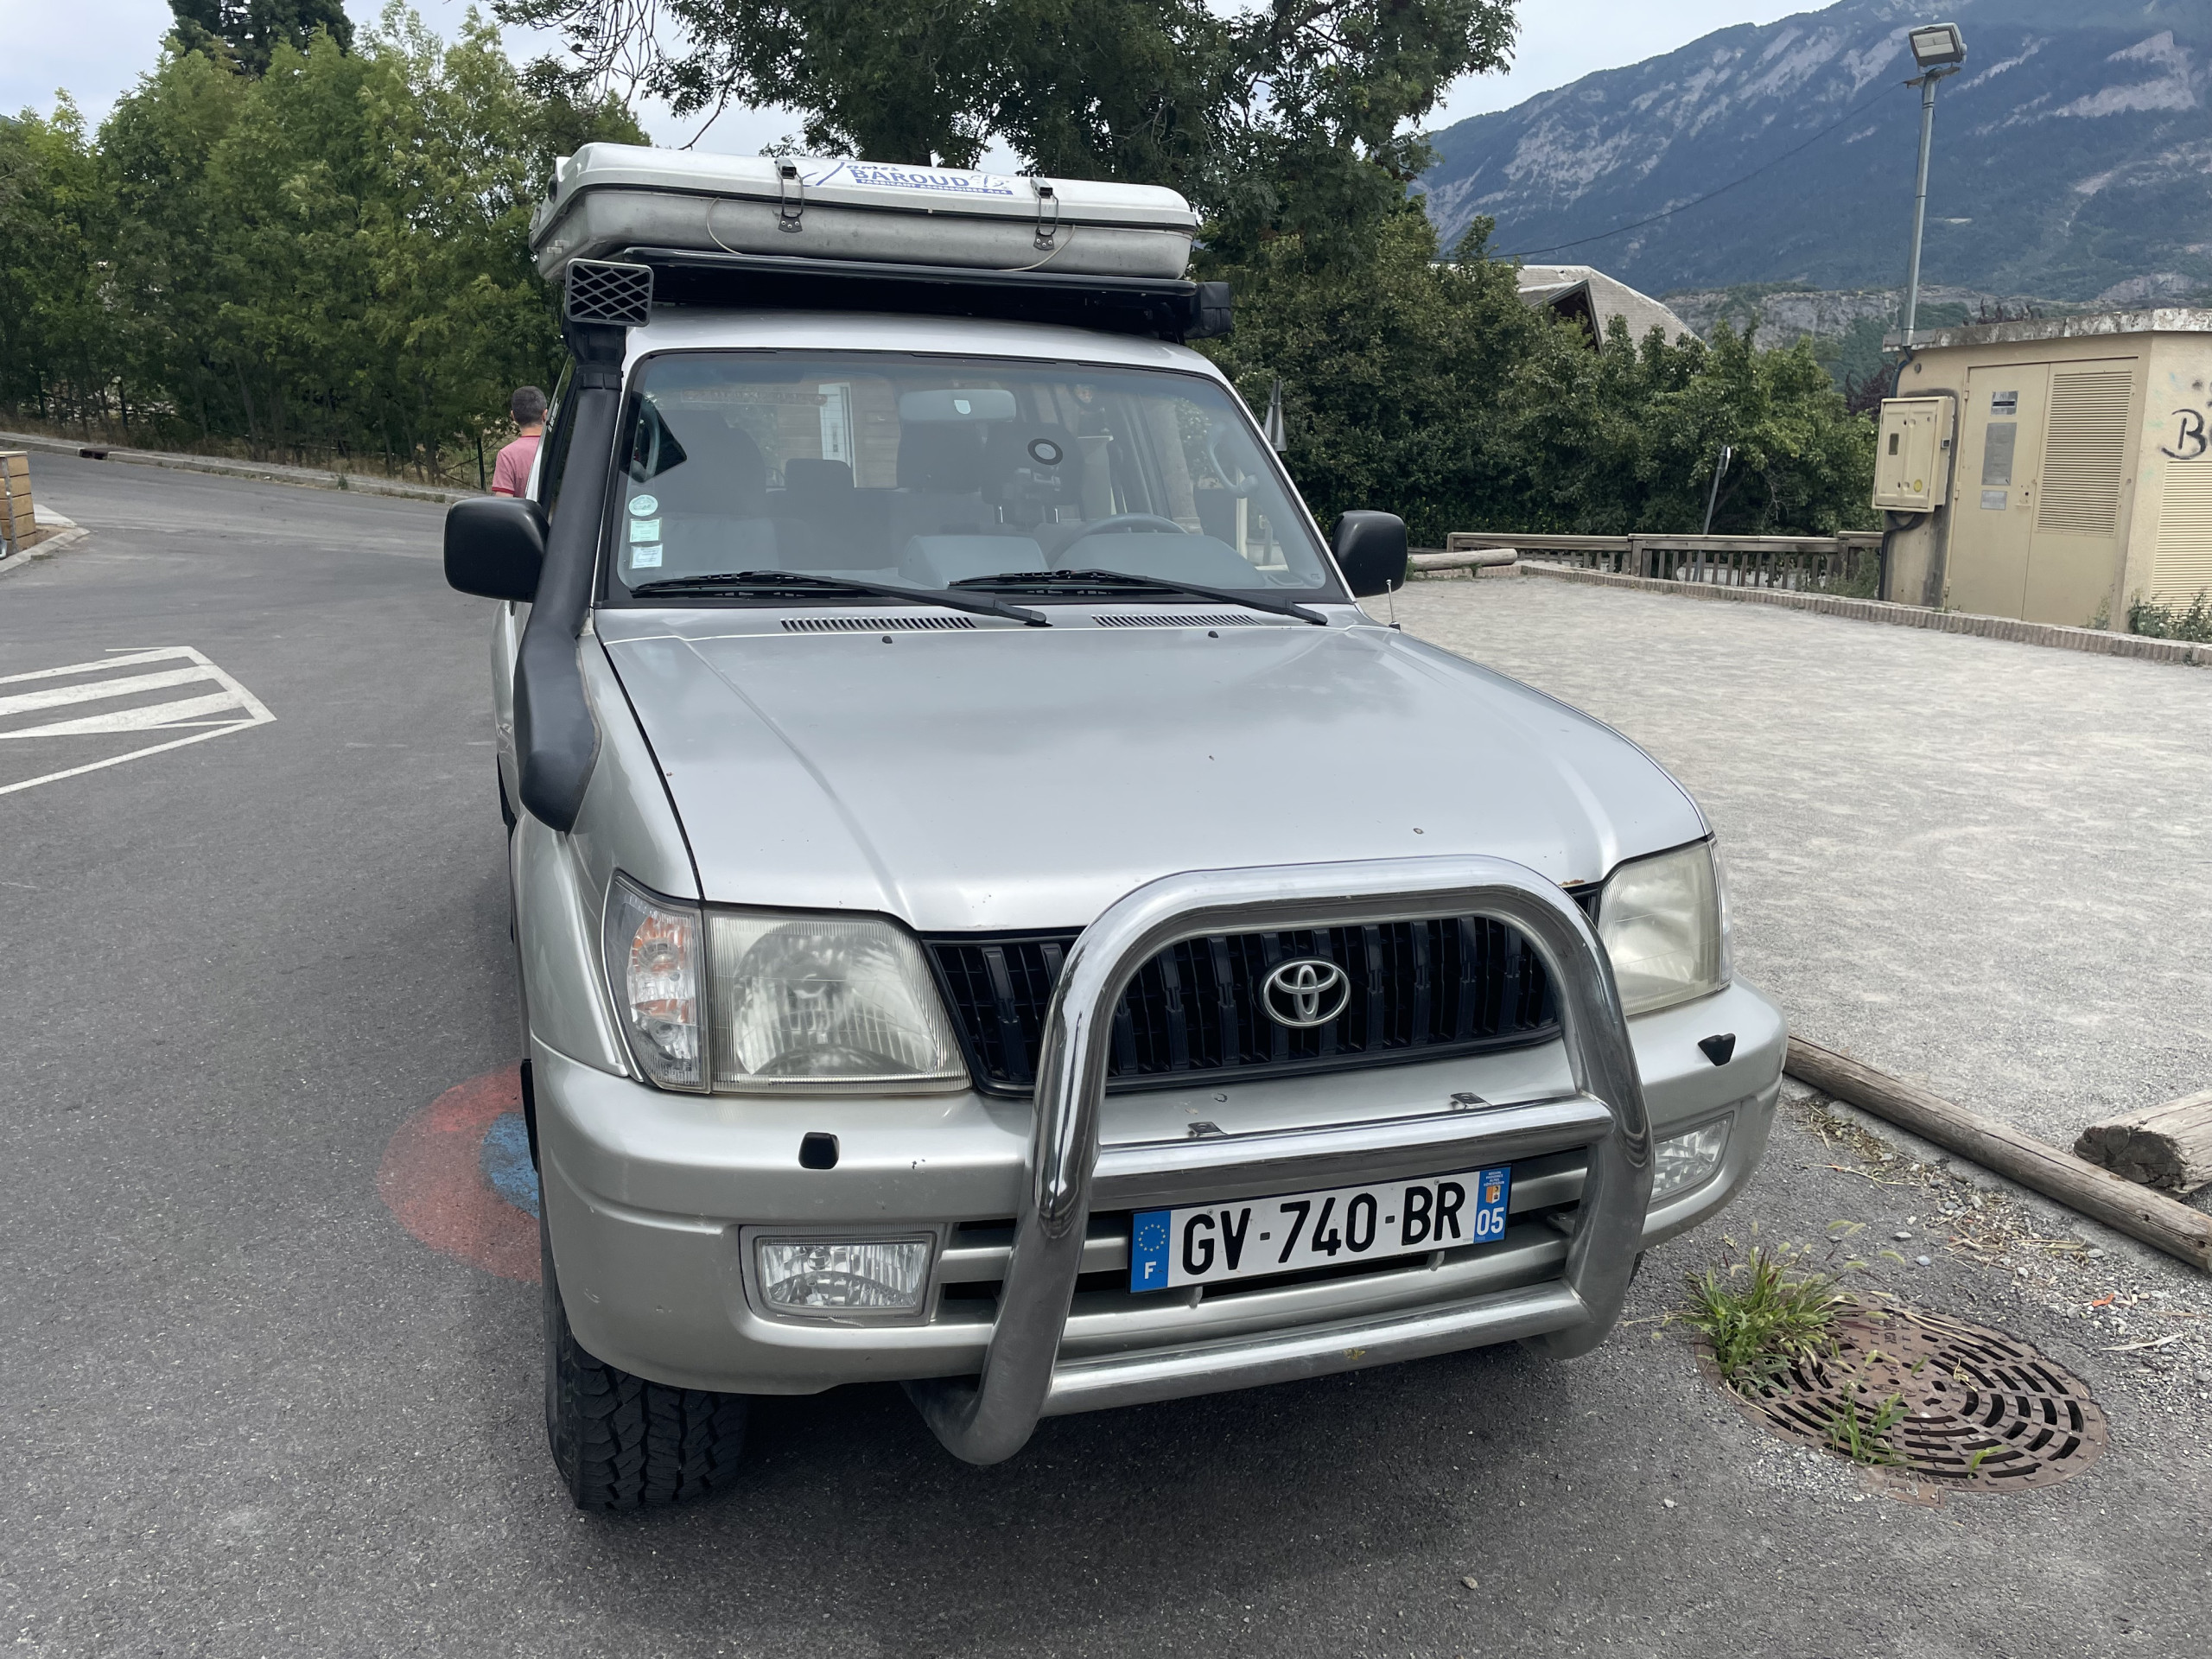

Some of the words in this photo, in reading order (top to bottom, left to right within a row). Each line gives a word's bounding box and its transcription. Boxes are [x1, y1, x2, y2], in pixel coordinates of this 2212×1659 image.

[850, 169, 969, 187] BAROUD
[1182, 1181, 1466, 1275] GV-740-BR
[1476, 1206, 1505, 1236] 05
[1144, 1261, 1157, 1280] F
